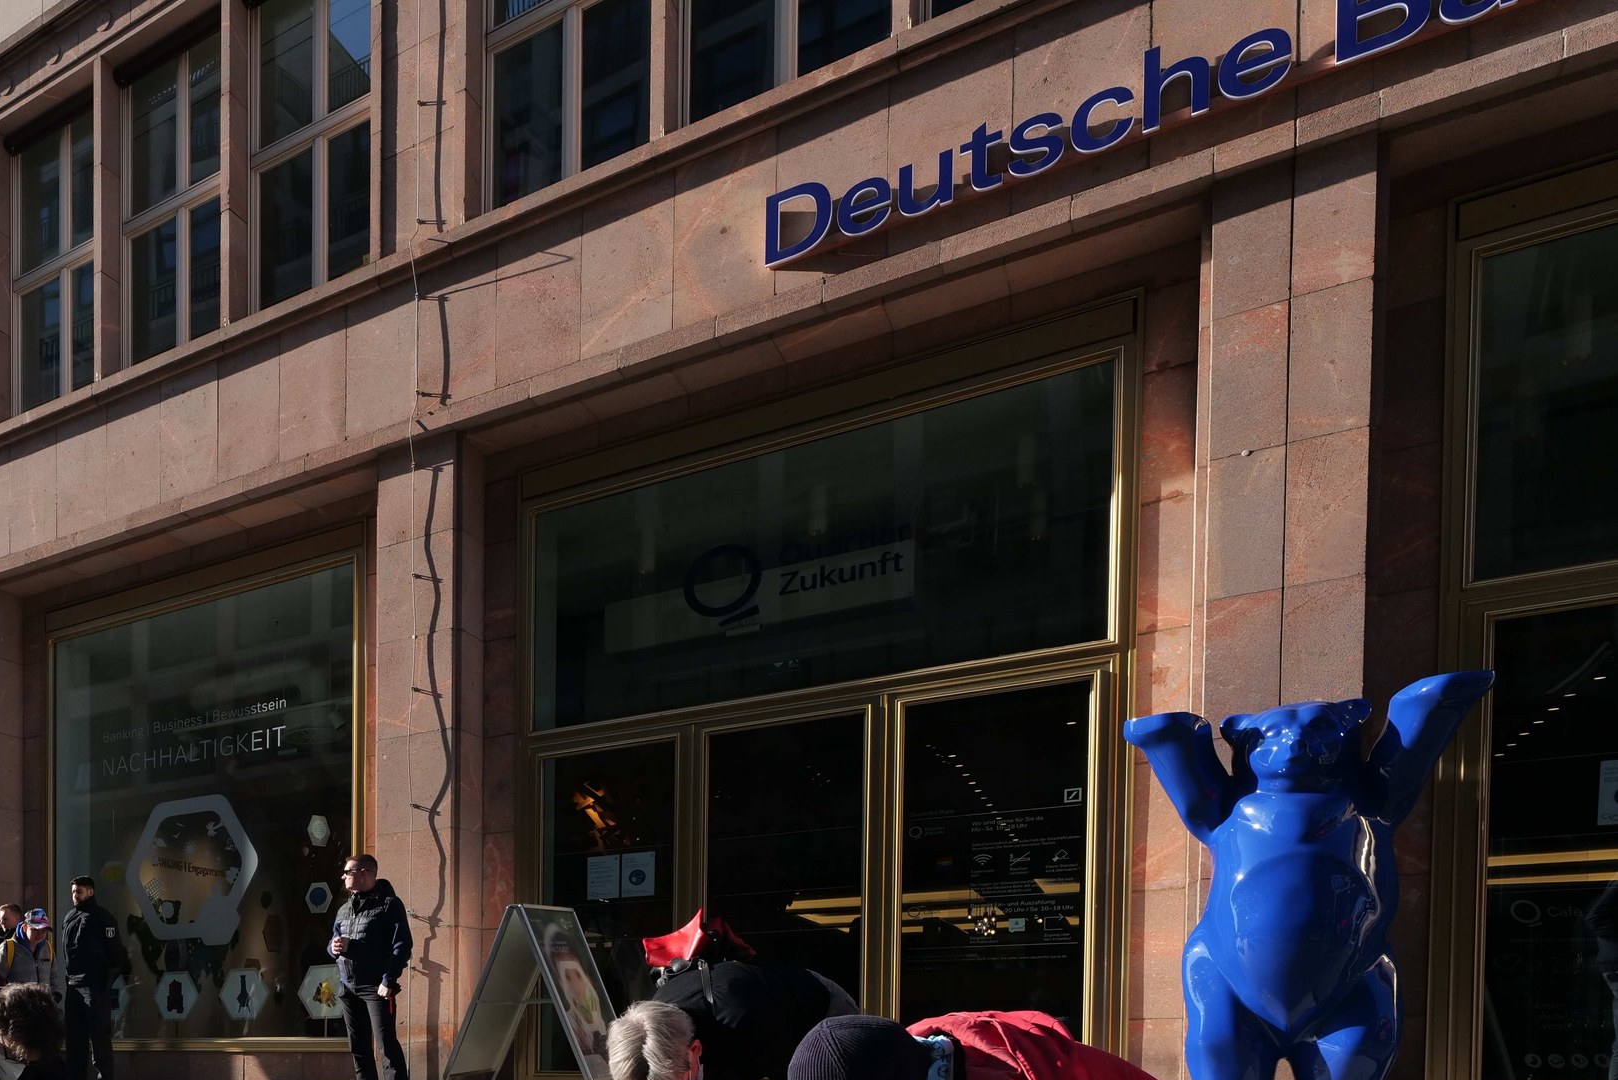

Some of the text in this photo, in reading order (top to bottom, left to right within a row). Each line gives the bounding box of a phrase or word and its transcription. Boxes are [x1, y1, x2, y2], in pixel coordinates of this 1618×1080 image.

[765, 26, 1292, 269] Deutsche
[779, 551, 905, 596] Zukunft
[102, 697, 287, 743] Banking Business Bewusstsein
[102, 725, 287, 777] NACHHALTIGKEIT
